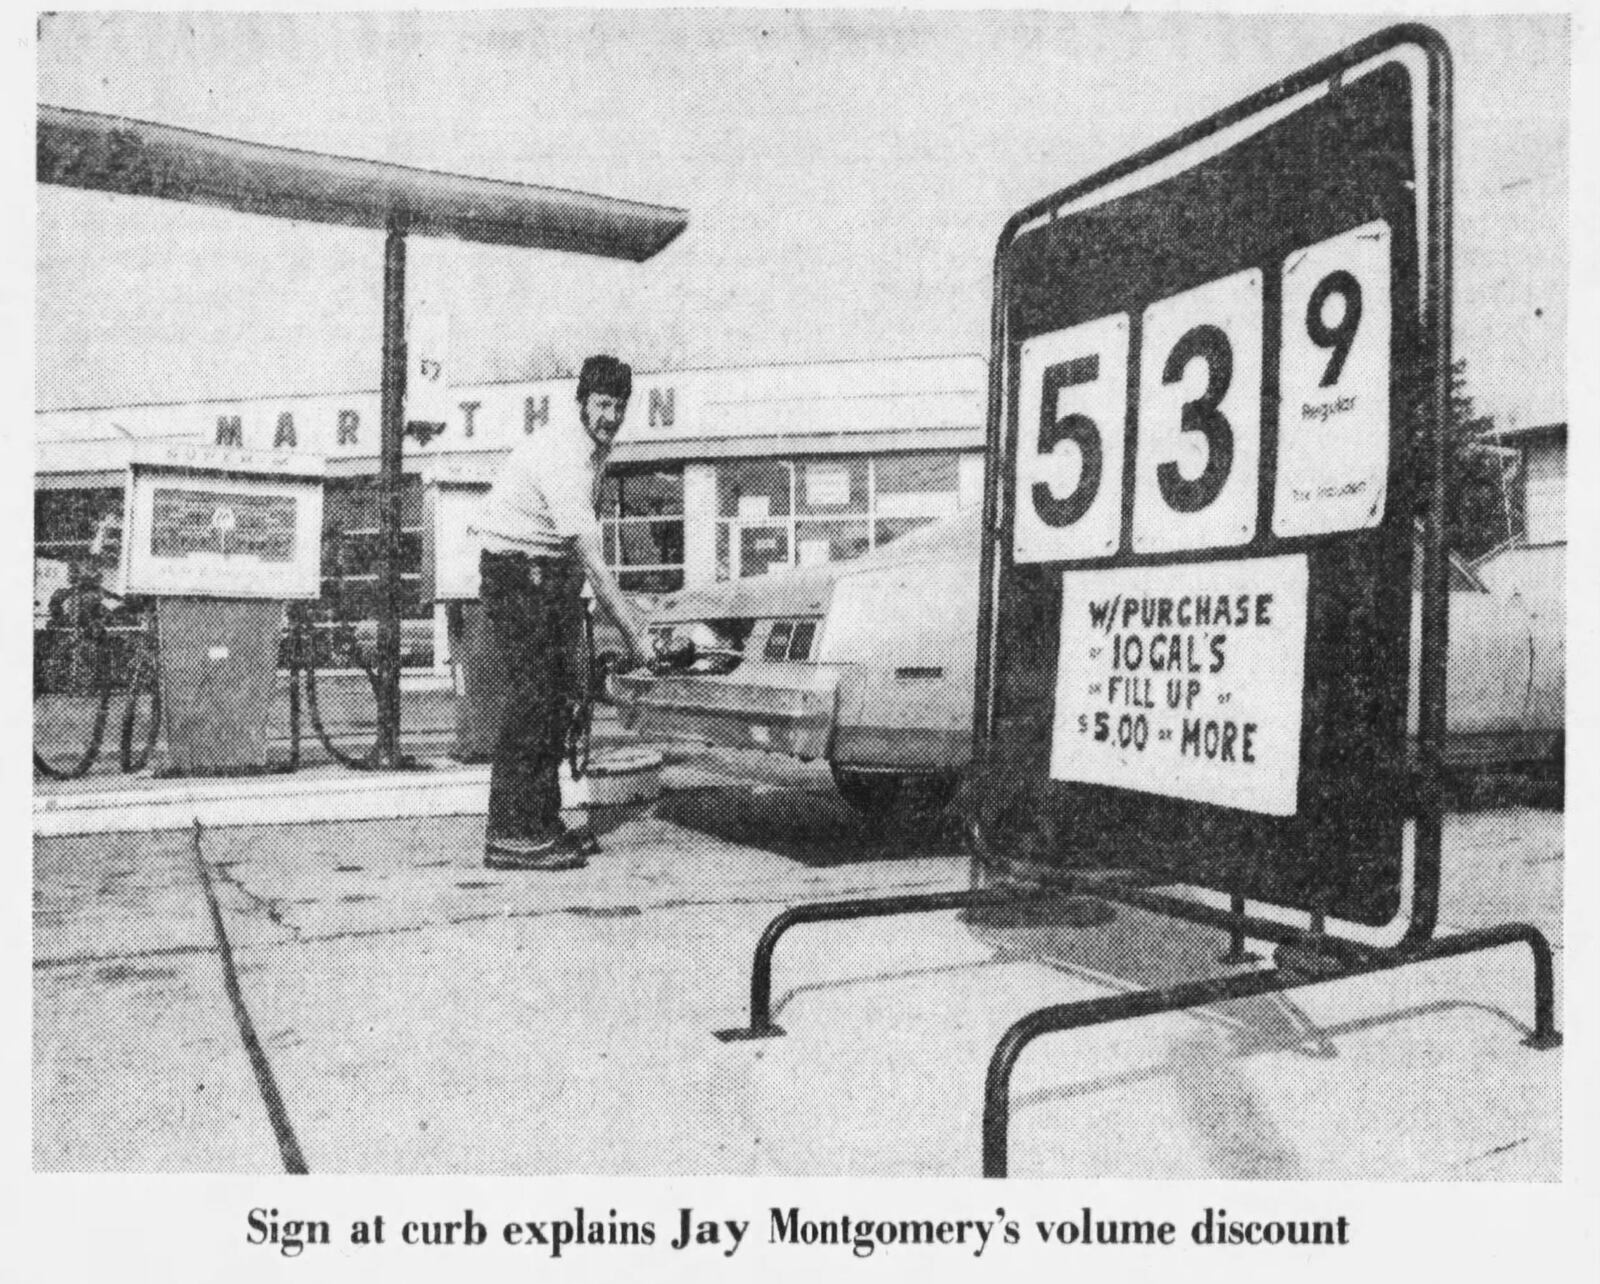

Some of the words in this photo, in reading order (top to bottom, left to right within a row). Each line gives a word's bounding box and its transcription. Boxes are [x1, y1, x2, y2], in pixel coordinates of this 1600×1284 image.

[215, 386, 677, 448] MARTHN
[1301, 395, 1357, 422] Regular
[1108, 675, 1155, 709] FILL
[1166, 678, 1201, 711] UP
[1180, 718, 1258, 763] MORE
